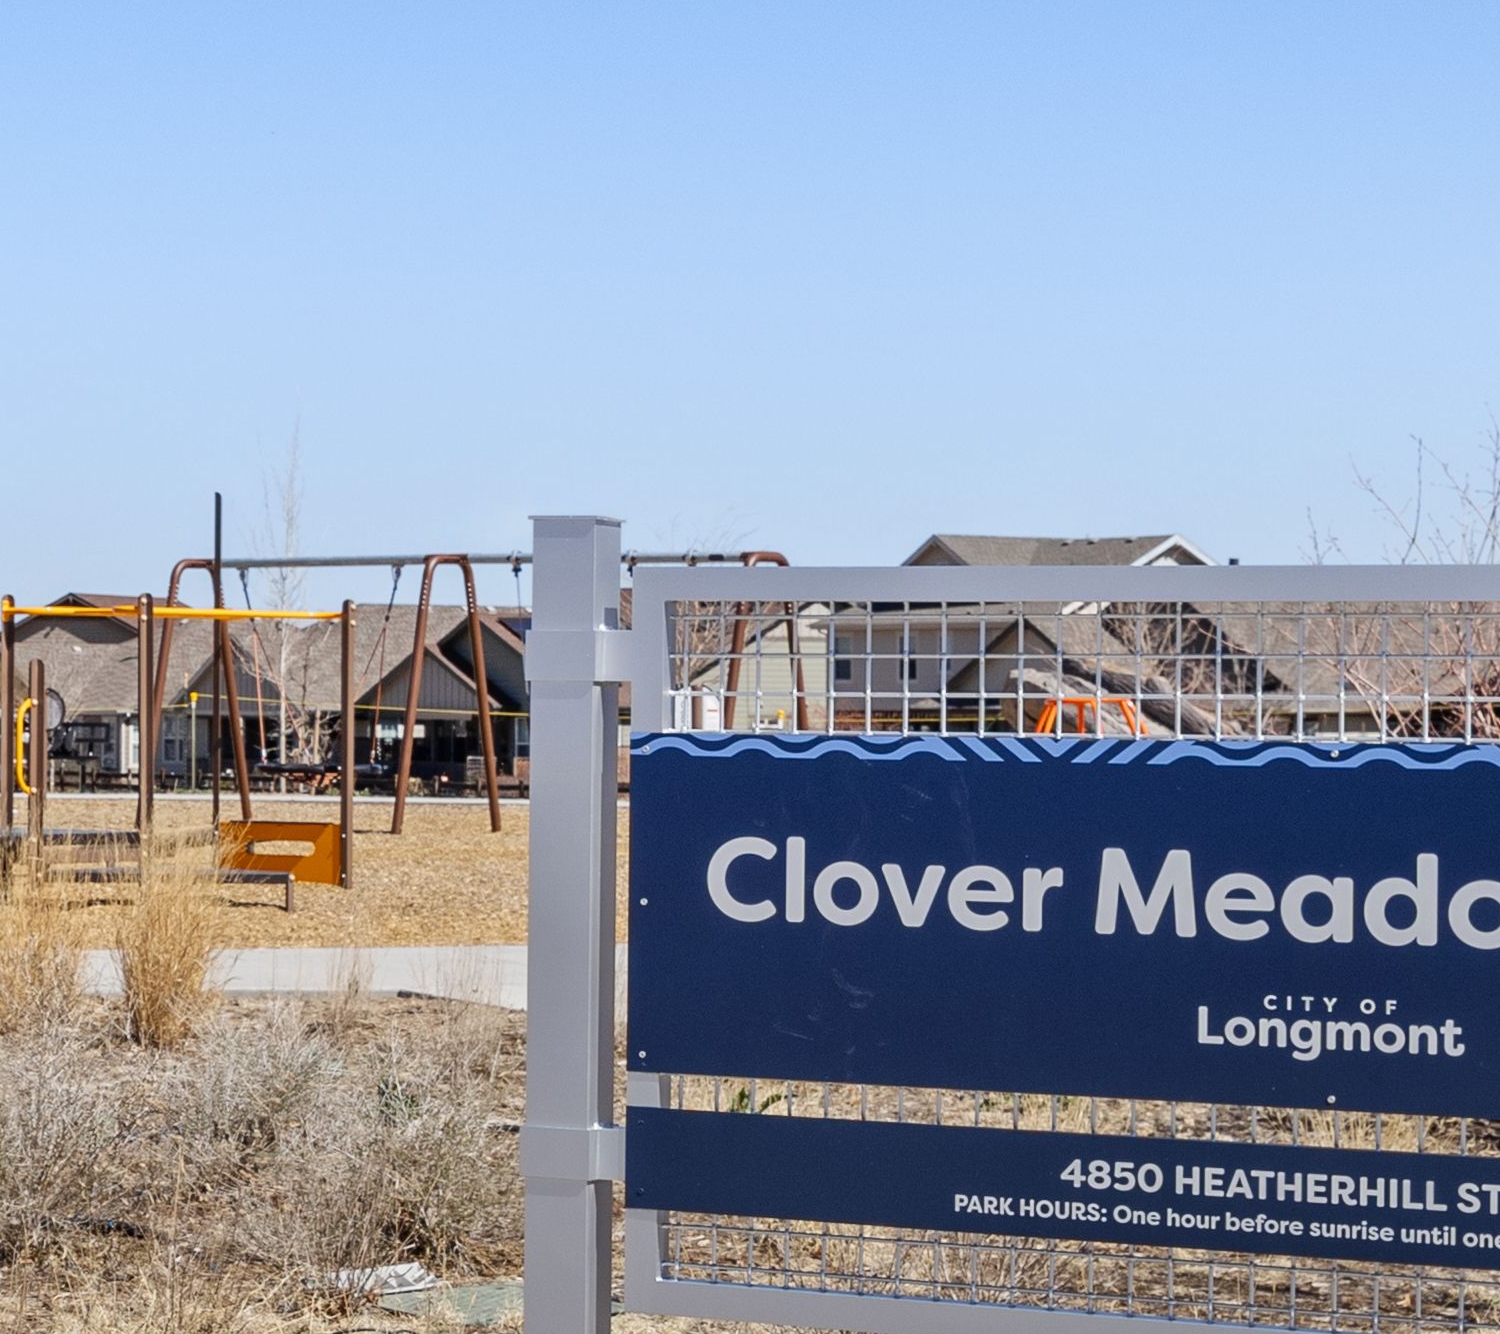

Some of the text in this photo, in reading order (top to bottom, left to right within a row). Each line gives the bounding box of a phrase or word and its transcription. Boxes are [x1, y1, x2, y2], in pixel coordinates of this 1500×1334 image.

[706, 836, 1064, 932] Clover
[1263, 994, 1397, 1016] CITY OF
[1197, 1005, 1466, 1061] Longmont
[1060, 1158, 1164, 1193] 4850
[1175, 1165, 1448, 1212] HEATHERHILL
[954, 1193, 1015, 1216] PARK
[1019, 1198, 1108, 1223] HOURS:
[1112, 1204, 1161, 1226] One
[1166, 1207, 1221, 1230] hour
[1225, 1211, 1304, 1236] before
[1309, 1220, 1395, 1242] sunrise
[1400, 1225, 1457, 1246] until
